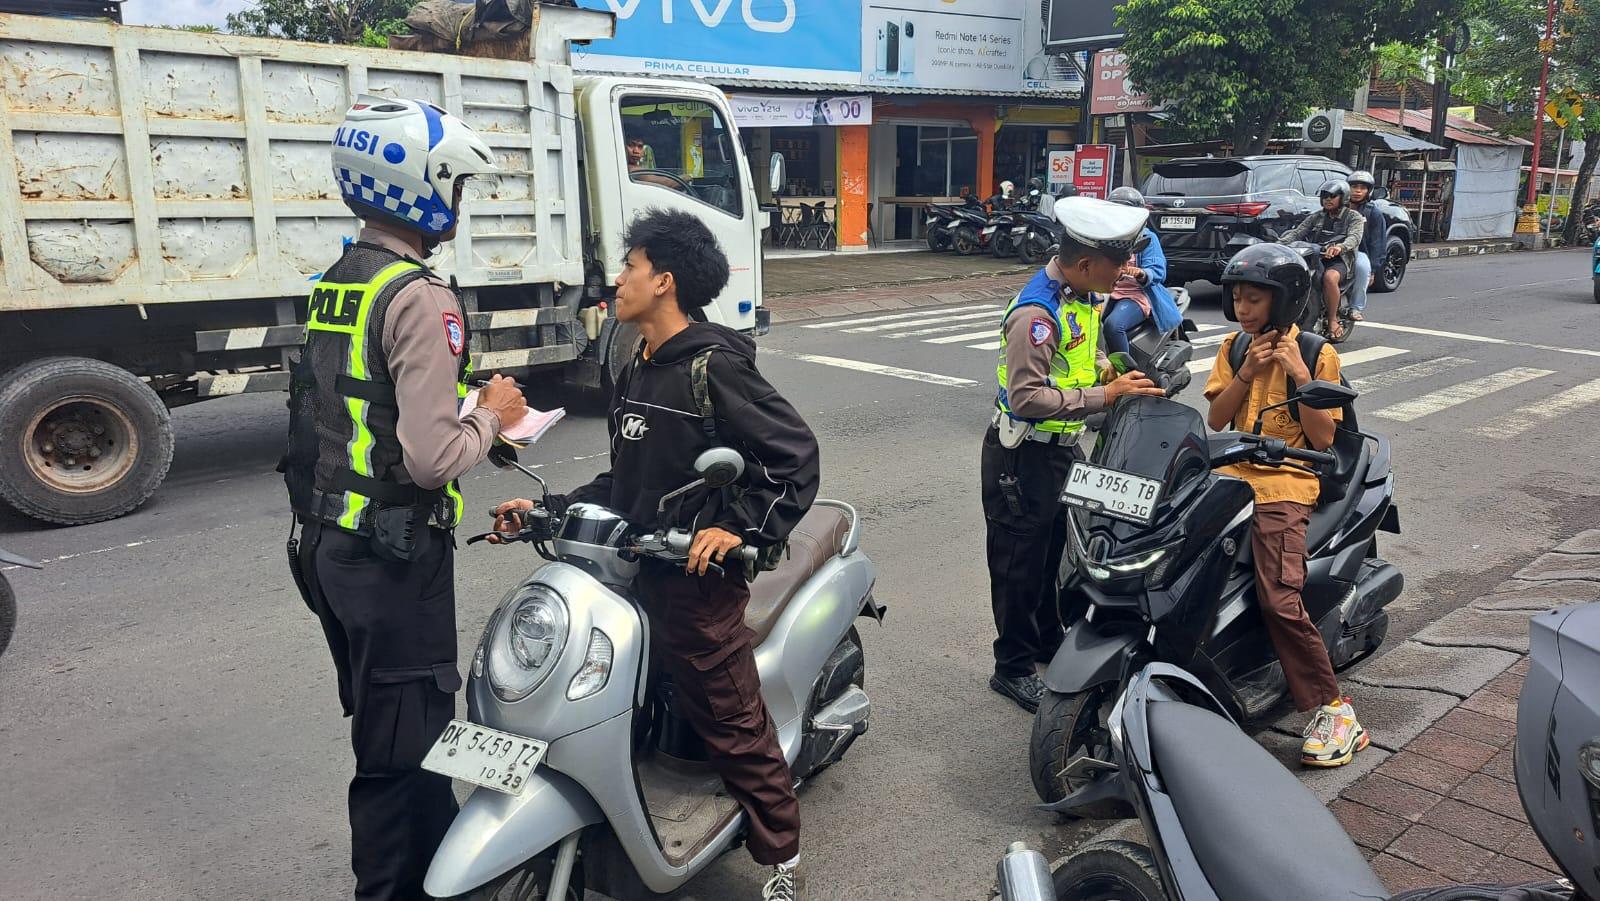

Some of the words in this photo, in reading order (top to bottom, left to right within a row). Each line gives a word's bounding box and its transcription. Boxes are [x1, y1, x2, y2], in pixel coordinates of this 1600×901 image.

[935, 30, 958, 41] Redmi
[959, 32, 977, 42] Note
[979, 33, 987, 43] 14
[989, 34, 1011, 45] Series
[644, 61, 684, 72] PRIMA
[687, 64, 750, 76] CELLULAR
[1101, 70, 1123, 80] DP
[737, 104, 759, 113] vivo
[1052, 158, 1069, 172] 5G
[308, 287, 365, 327] POLISI
[1072, 468, 1091, 485] DK
[1095, 473, 1130, 494] 3956
[1137, 483, 1156, 500] TB
[441, 725, 468, 746] DK
[467, 731, 513, 759] 5459
[514, 743, 540, 766] TZ
